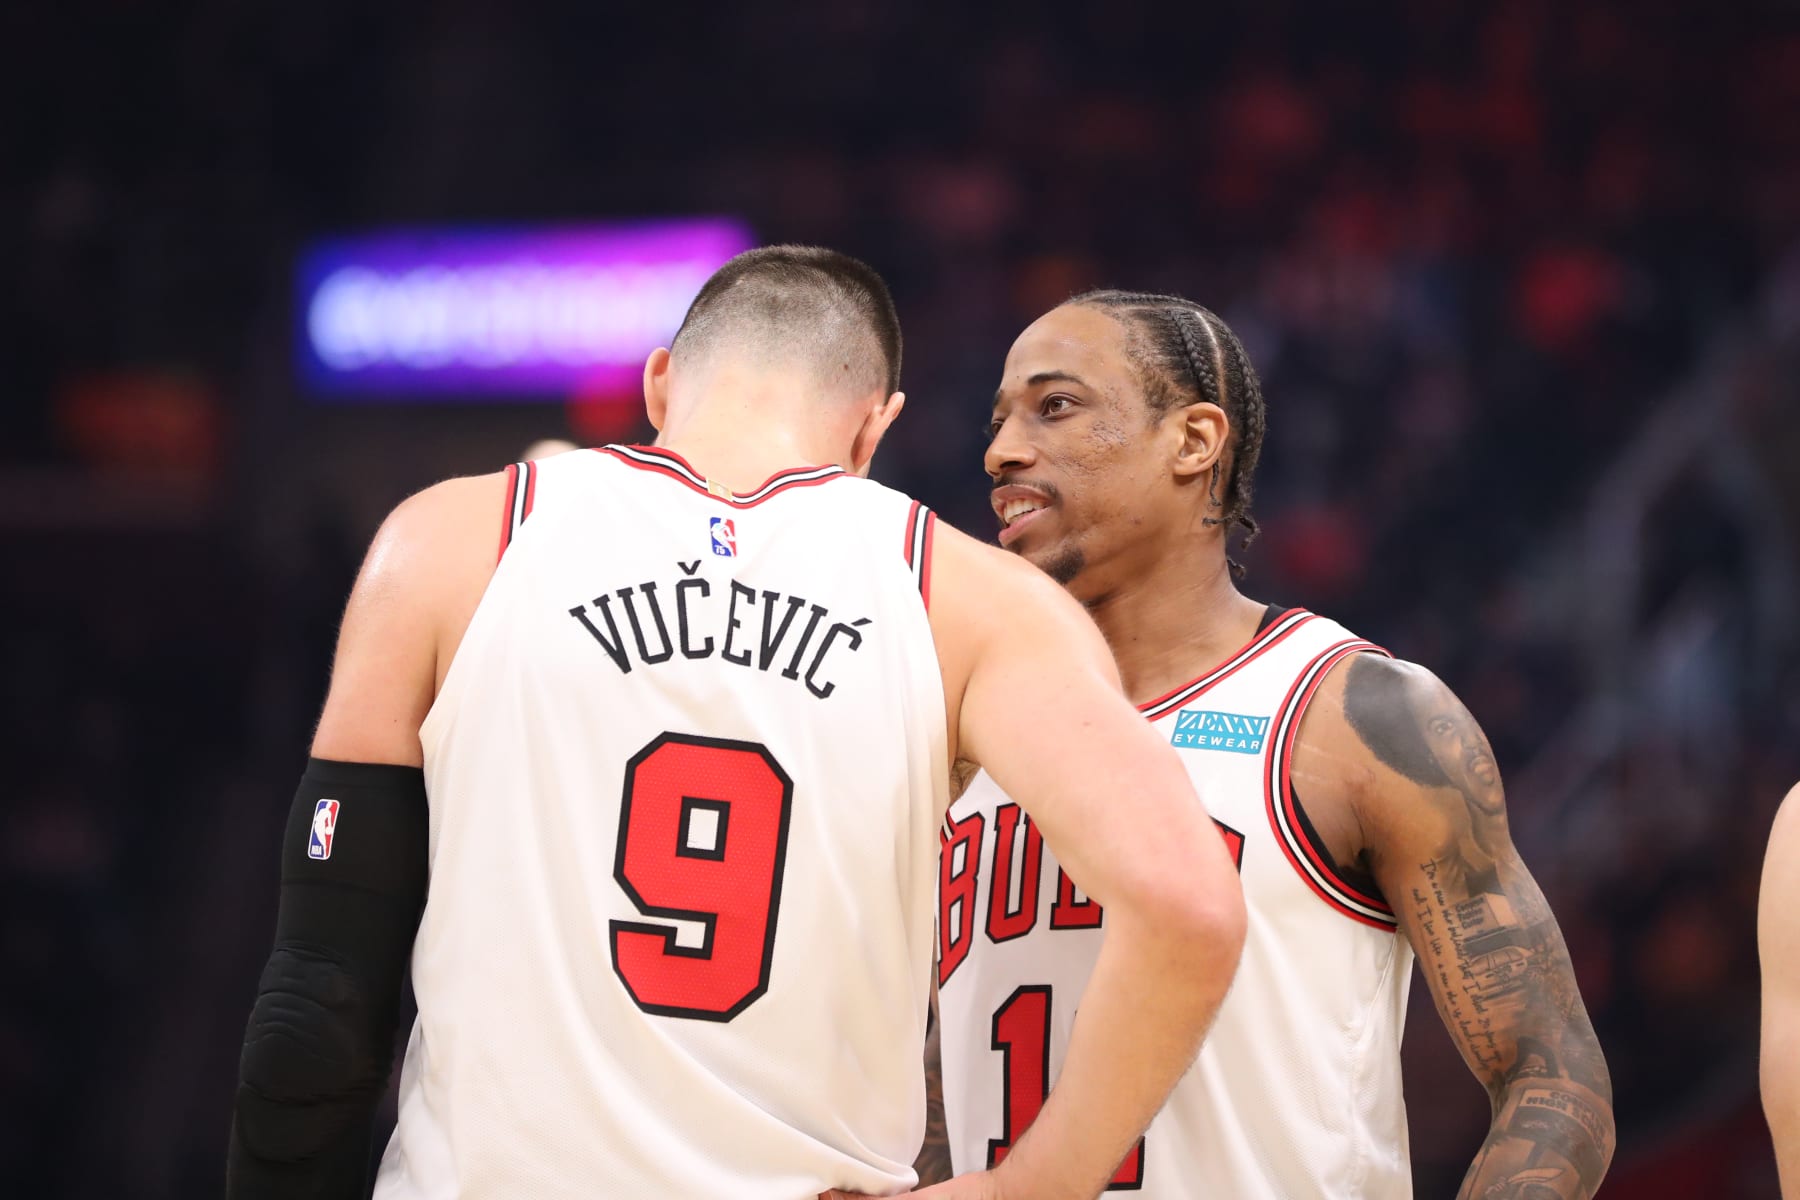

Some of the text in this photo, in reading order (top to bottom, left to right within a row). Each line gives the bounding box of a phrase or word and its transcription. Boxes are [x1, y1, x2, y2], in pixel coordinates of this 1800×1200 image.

[568, 559, 873, 700] VUČEVIĆ
[1174, 734, 1260, 750] EYEWEAR
[1180, 713, 1267, 735] ZENNI
[609, 731, 794, 1023] 9
